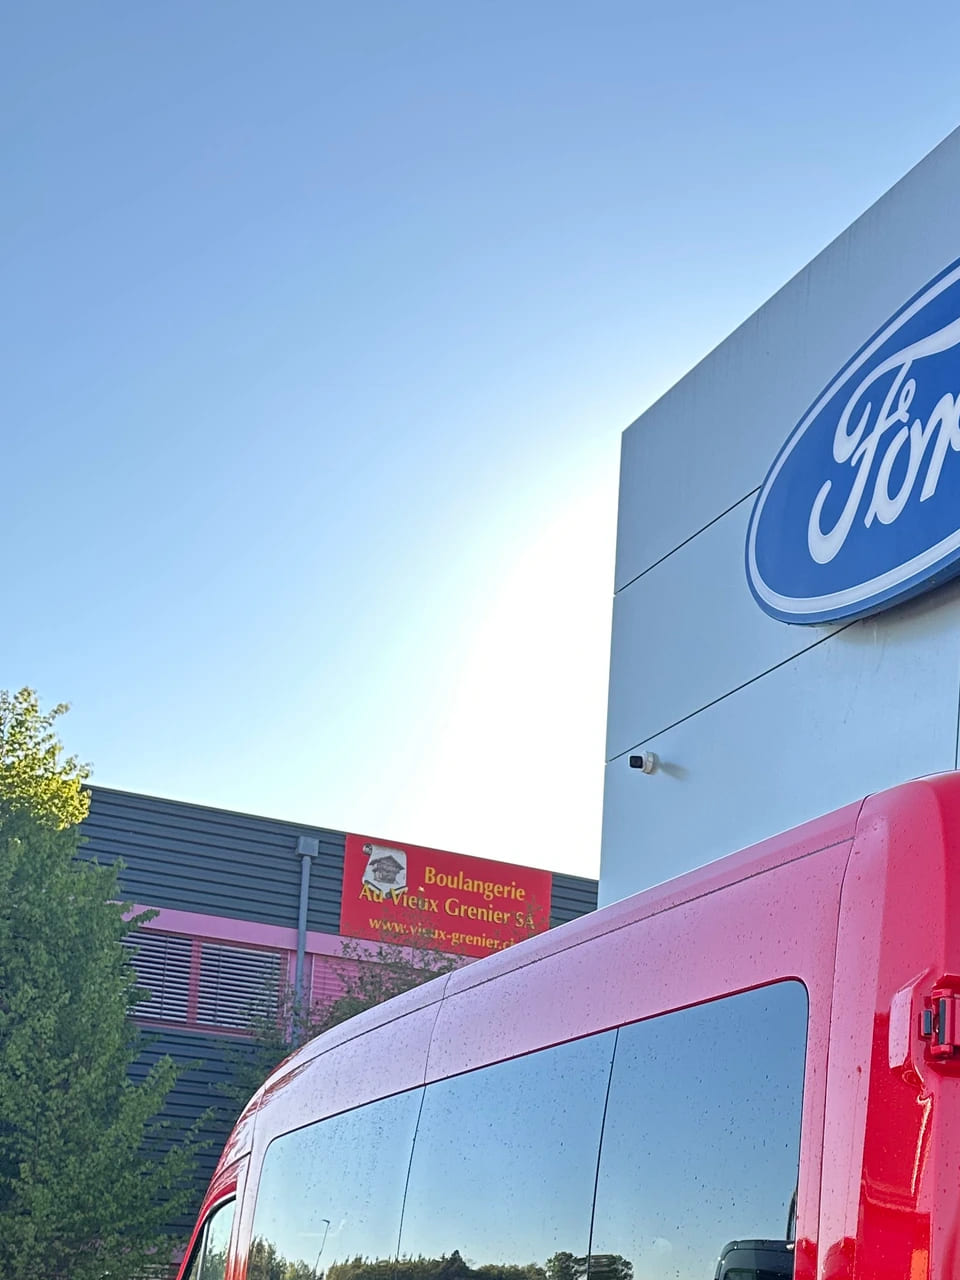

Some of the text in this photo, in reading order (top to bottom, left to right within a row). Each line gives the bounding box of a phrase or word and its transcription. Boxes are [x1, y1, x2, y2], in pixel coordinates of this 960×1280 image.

[424, 866, 526, 902] Boulangerie
[358, 882, 536, 930] Au Vieux Grenier SA
